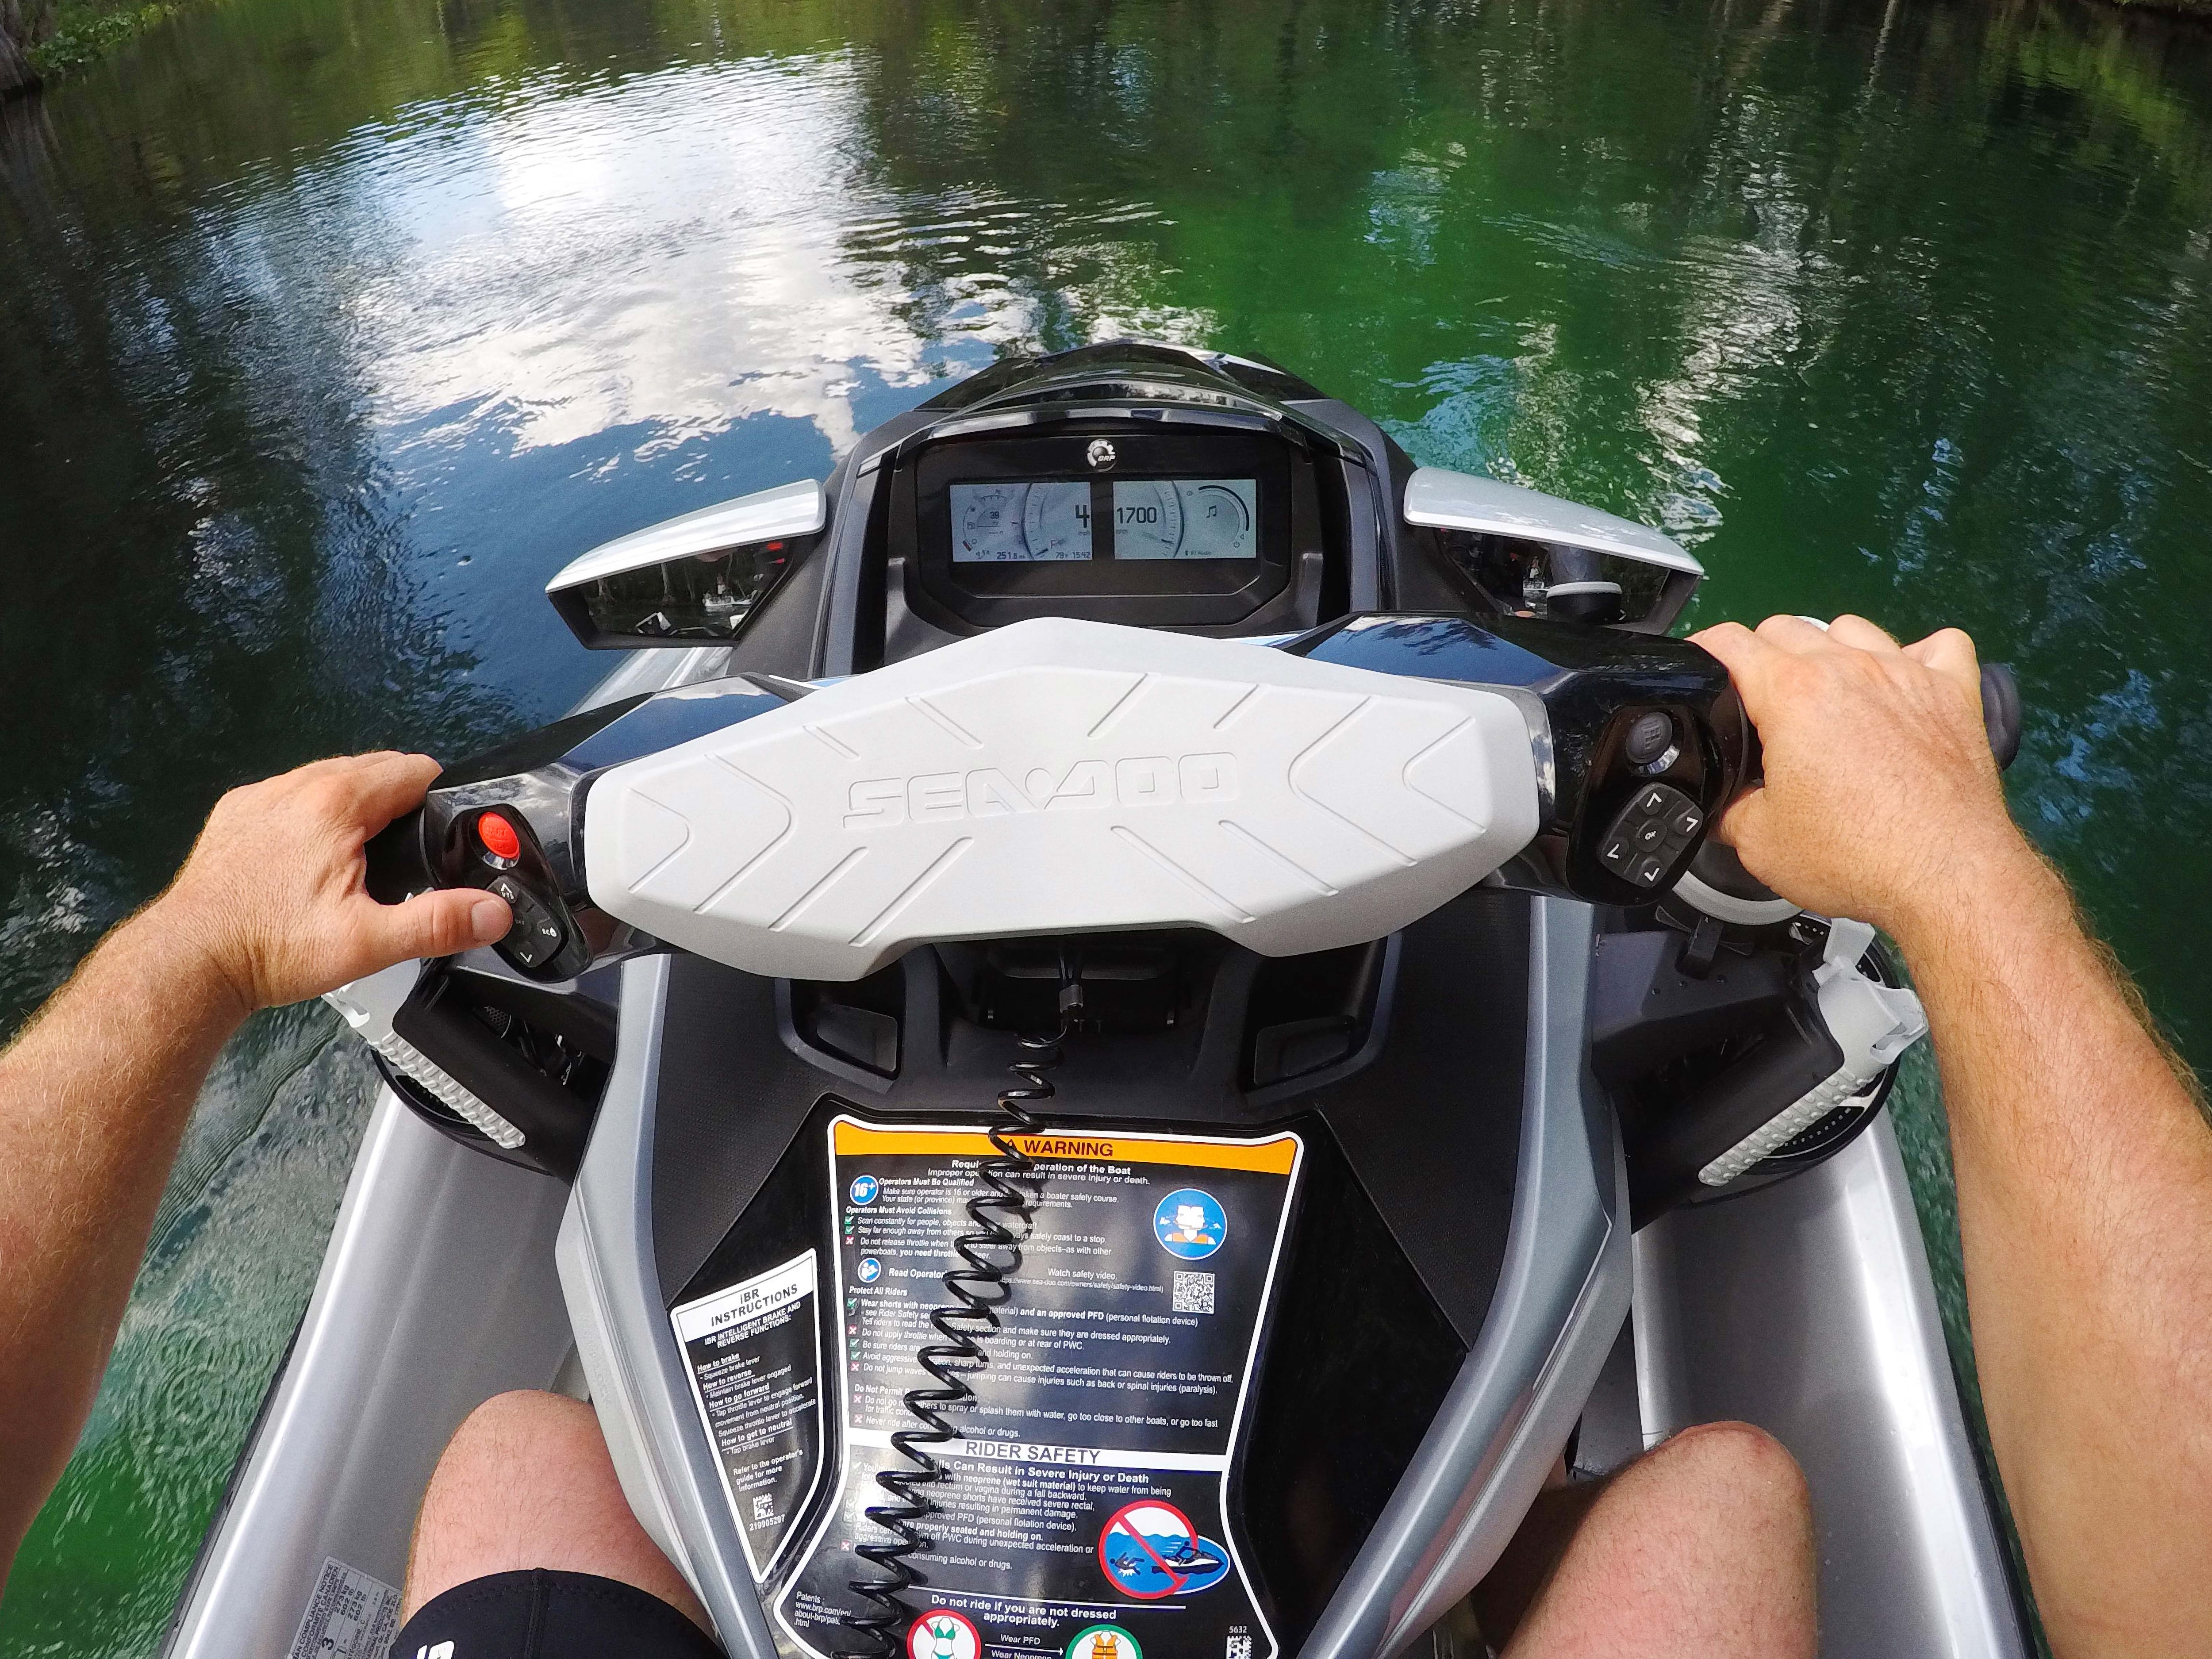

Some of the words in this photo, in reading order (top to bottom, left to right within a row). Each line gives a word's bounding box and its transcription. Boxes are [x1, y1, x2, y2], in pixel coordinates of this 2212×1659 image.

[1075, 505, 1090, 528] 4
[1117, 507, 1157, 524] 1700
[1024, 1140, 1113, 1156] WARNING
[928, 1168, 963, 1177] Improper
[1088, 1173, 1111, 1184] injury
[1124, 1176, 1150, 1185] death.
[1108, 1166, 1131, 1175] Boat
[854, 1183, 875, 1197] 16+
[942, 1178, 974, 1187] Qualified
[1071, 1193, 1091, 1202] safety
[846, 1206, 877, 1214] Operators
[918, 1207, 952, 1215] Collisions
[1030, 1233, 1052, 1242] safely
[1090, 1235, 1105, 1244] stop
[889, 1268, 908, 1277] Read
[1048, 1268, 1070, 1277] Watch
[1072, 1270, 1094, 1280] safety
[1096, 1271, 1117, 1279] video.
[741, 1289, 759, 1304] IBR
[849, 1286, 872, 1295] Protect
[711, 1284, 798, 1327] INSTRUCTIONS
[861, 1299, 878, 1307] Wear
[879, 1300, 902, 1309] shorts
[904, 1301, 918, 1309] with
[704, 1336, 716, 1345] IBR
[718, 1319, 761, 1340] INTELLIGENT
[762, 1309, 786, 1322] BRAKE
[787, 1301, 801, 1313] AND
[1020, 1308, 1035, 1316] and
[1048, 1311, 1085, 1320] approved
[1106, 1313, 1140, 1322] (personal
[1142, 1314, 1170, 1324] flotation
[1172, 1316, 1198, 1328] device)
[717, 1332, 749, 1348] REVERSE
[751, 1314, 791, 1336] FUNCTIONS:
[1059, 1329, 1074, 1339] they
[1091, 1331, 1120, 1340] dressed
[1121, 1333, 1171, 1345] appropriately.
[985, 1336, 1016, 1347] boarding
[994, 1350, 1019, 1360] holding
[1013, 1364, 1055, 1373] unexpected
[1056, 1366, 1100, 1376] acceleration
[1102, 1368, 1116, 1376] that
[1156, 1371, 1177, 1380] riders
[1187, 1373, 1196, 1381] be
[1198, 1373, 1221, 1382] thrown
[1223, 1375, 1233, 1383] off.
[1038, 1376, 1064, 1386] injuries
[1067, 1378, 1084, 1386] such
[1098, 1379, 1115, 1388] back
[1127, 1382, 1148, 1391] spinal
[1151, 1382, 1177, 1392] injuries
[1179, 1385, 1217, 1395] (paralysis).
[709, 1399, 723, 1409] How
[734, 1394, 742, 1403] go
[744, 1382, 770, 1398] forward
[1125, 1415, 1144, 1424] other
[1146, 1417, 1169, 1426] boats,
[959, 1425, 986, 1434] alcohol
[998, 1428, 1020, 1438] drugs.
[966, 1441, 1021, 1458] RIDER
[1027, 1445, 1101, 1464] SAFETY
[733, 1466, 750, 1476] Refer
[772, 1448, 803, 1464] operator's
[736, 1474, 753, 1485] guide
[766, 1465, 782, 1475] more
[953, 1461, 974, 1471] Can
[977, 1463, 1011, 1475] Result
[1028, 1467, 1065, 1478] Severe
[1069, 1470, 1100, 1483] Injury
[1103, 1473, 1114, 1482] or
[1118, 1473, 1149, 1483] Death
[1087, 1483, 1106, 1494] keep
[1108, 1485, 1129, 1494] water
[1132, 1486, 1148, 1494] from
[1151, 1486, 1171, 1498] being
[908, 1552, 947, 1564] consuming
[949, 1557, 976, 1567] alcohol
[988, 1560, 1013, 1570] drugs.
[299, 1594, 323, 1644] COMPLIANCE
[319, 1564, 333, 1593] NOTICE
[334, 1596, 344, 1614] 273
[342, 1585, 349, 1595] kg
[931, 1594, 946, 1604] Do
[949, 1597, 967, 1607] not
[970, 1600, 991, 1610] ride
[995, 1602, 1002, 1611] if
[1004, 1605, 1025, 1614] you
[1050, 1607, 1068, 1616] not
[1071, 1608, 1117, 1620] dressed
[983, 1613, 1060, 1628] appropriately.
[321, 1637, 334, 1651] 3
[1000, 1634, 1022, 1643] Wear
[1023, 1636, 1040, 1645] PFD
